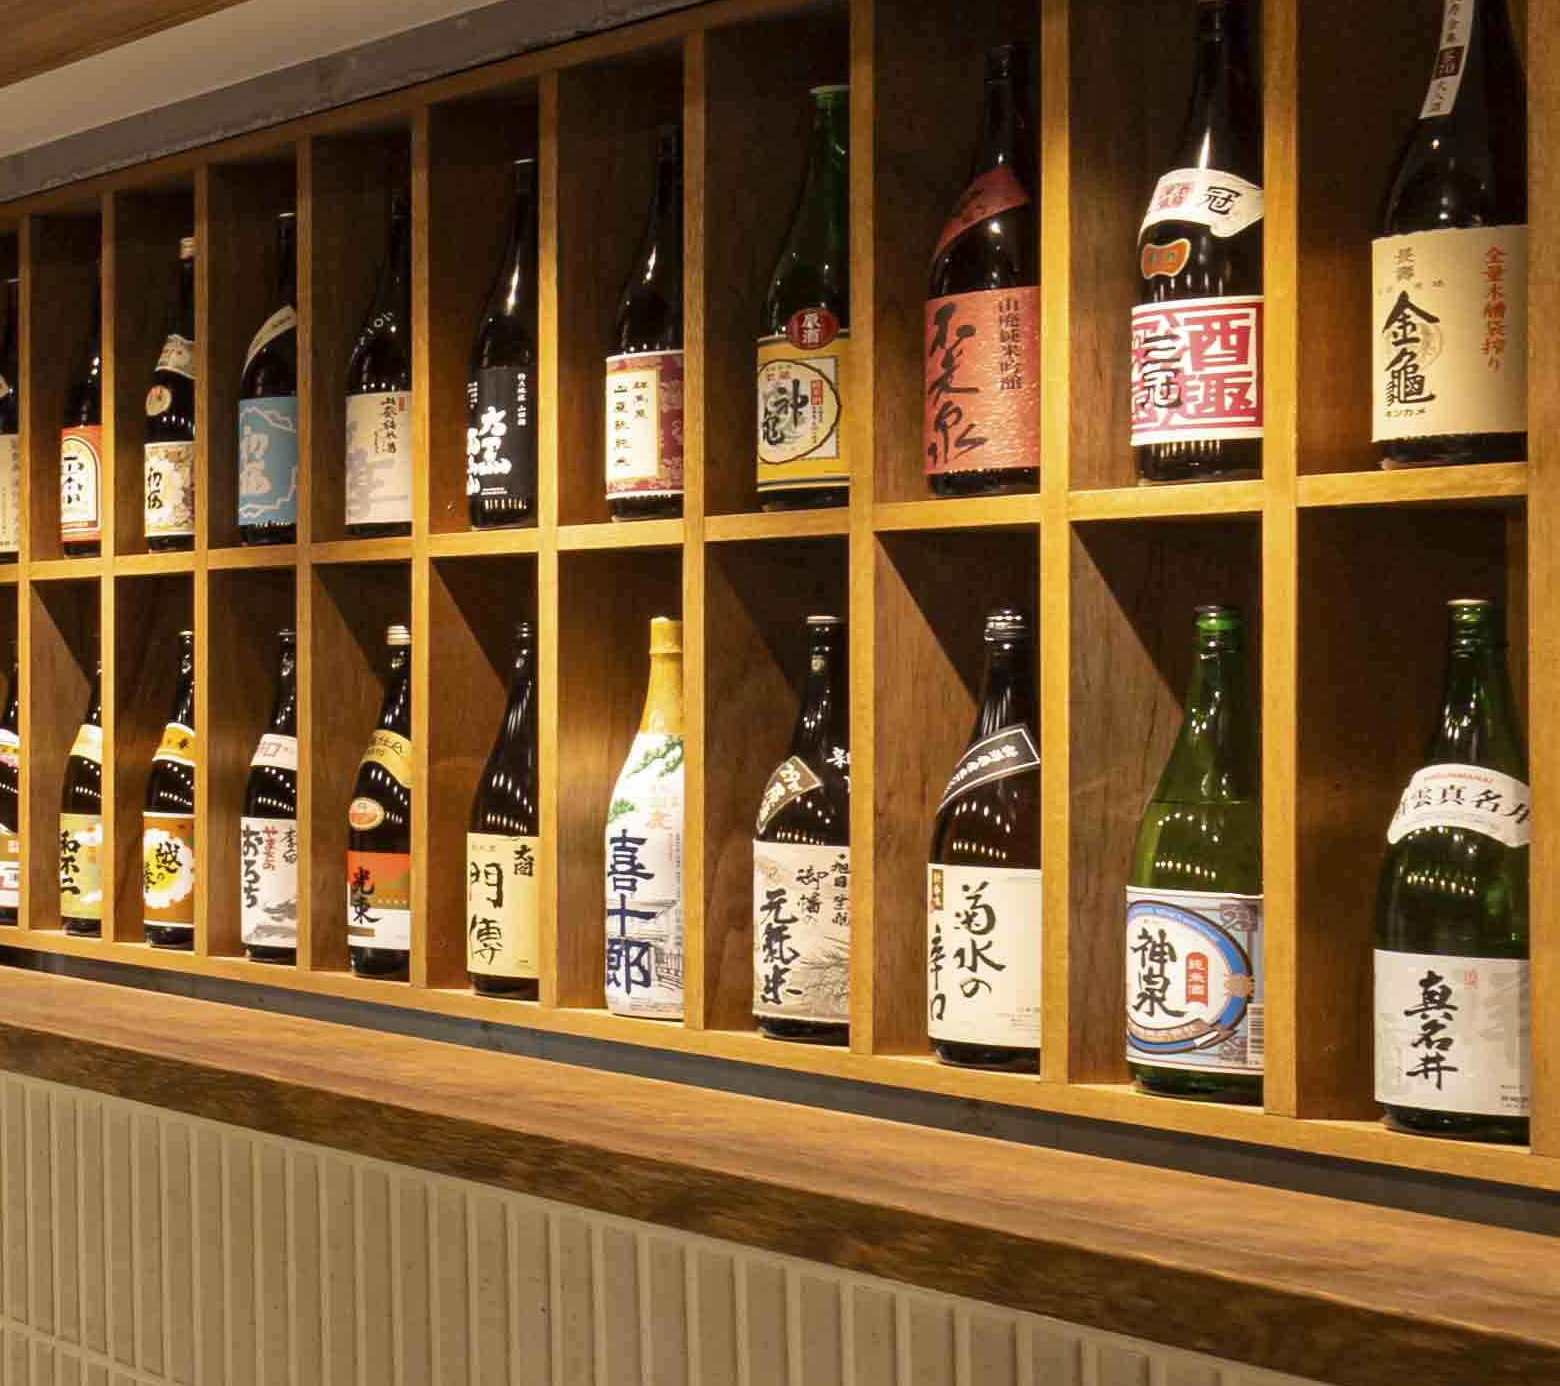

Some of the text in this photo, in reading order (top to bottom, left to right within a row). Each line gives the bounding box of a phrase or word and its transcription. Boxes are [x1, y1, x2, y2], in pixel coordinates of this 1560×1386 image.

[242, 825, 263, 908] おろち
[953, 881, 1006, 999] 菊水の
[1130, 927, 1185, 1017] 神泉
